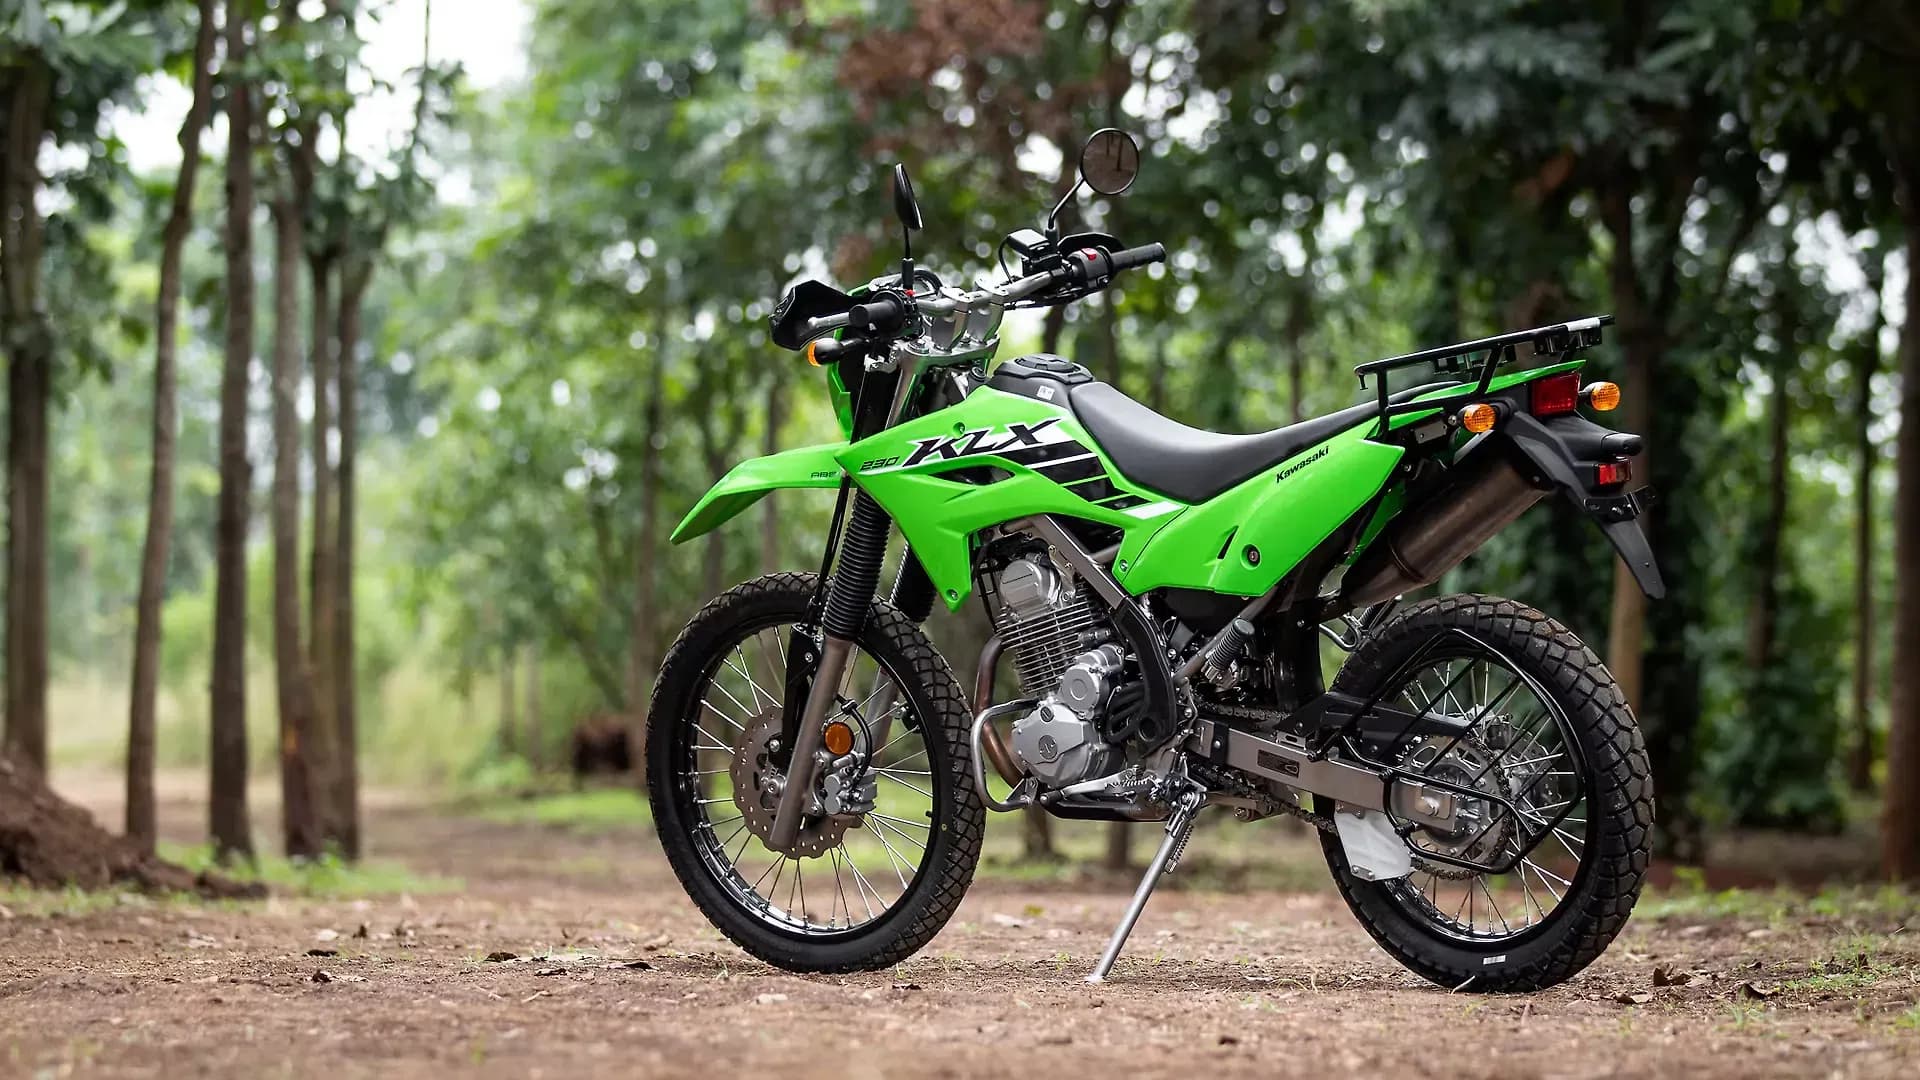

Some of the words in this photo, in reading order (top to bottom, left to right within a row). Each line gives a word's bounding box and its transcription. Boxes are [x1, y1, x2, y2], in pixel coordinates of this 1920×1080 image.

[902, 418, 1062, 468] KLX
[860, 456, 900, 471] 230
[1276, 445, 1329, 483] Kawasaki
